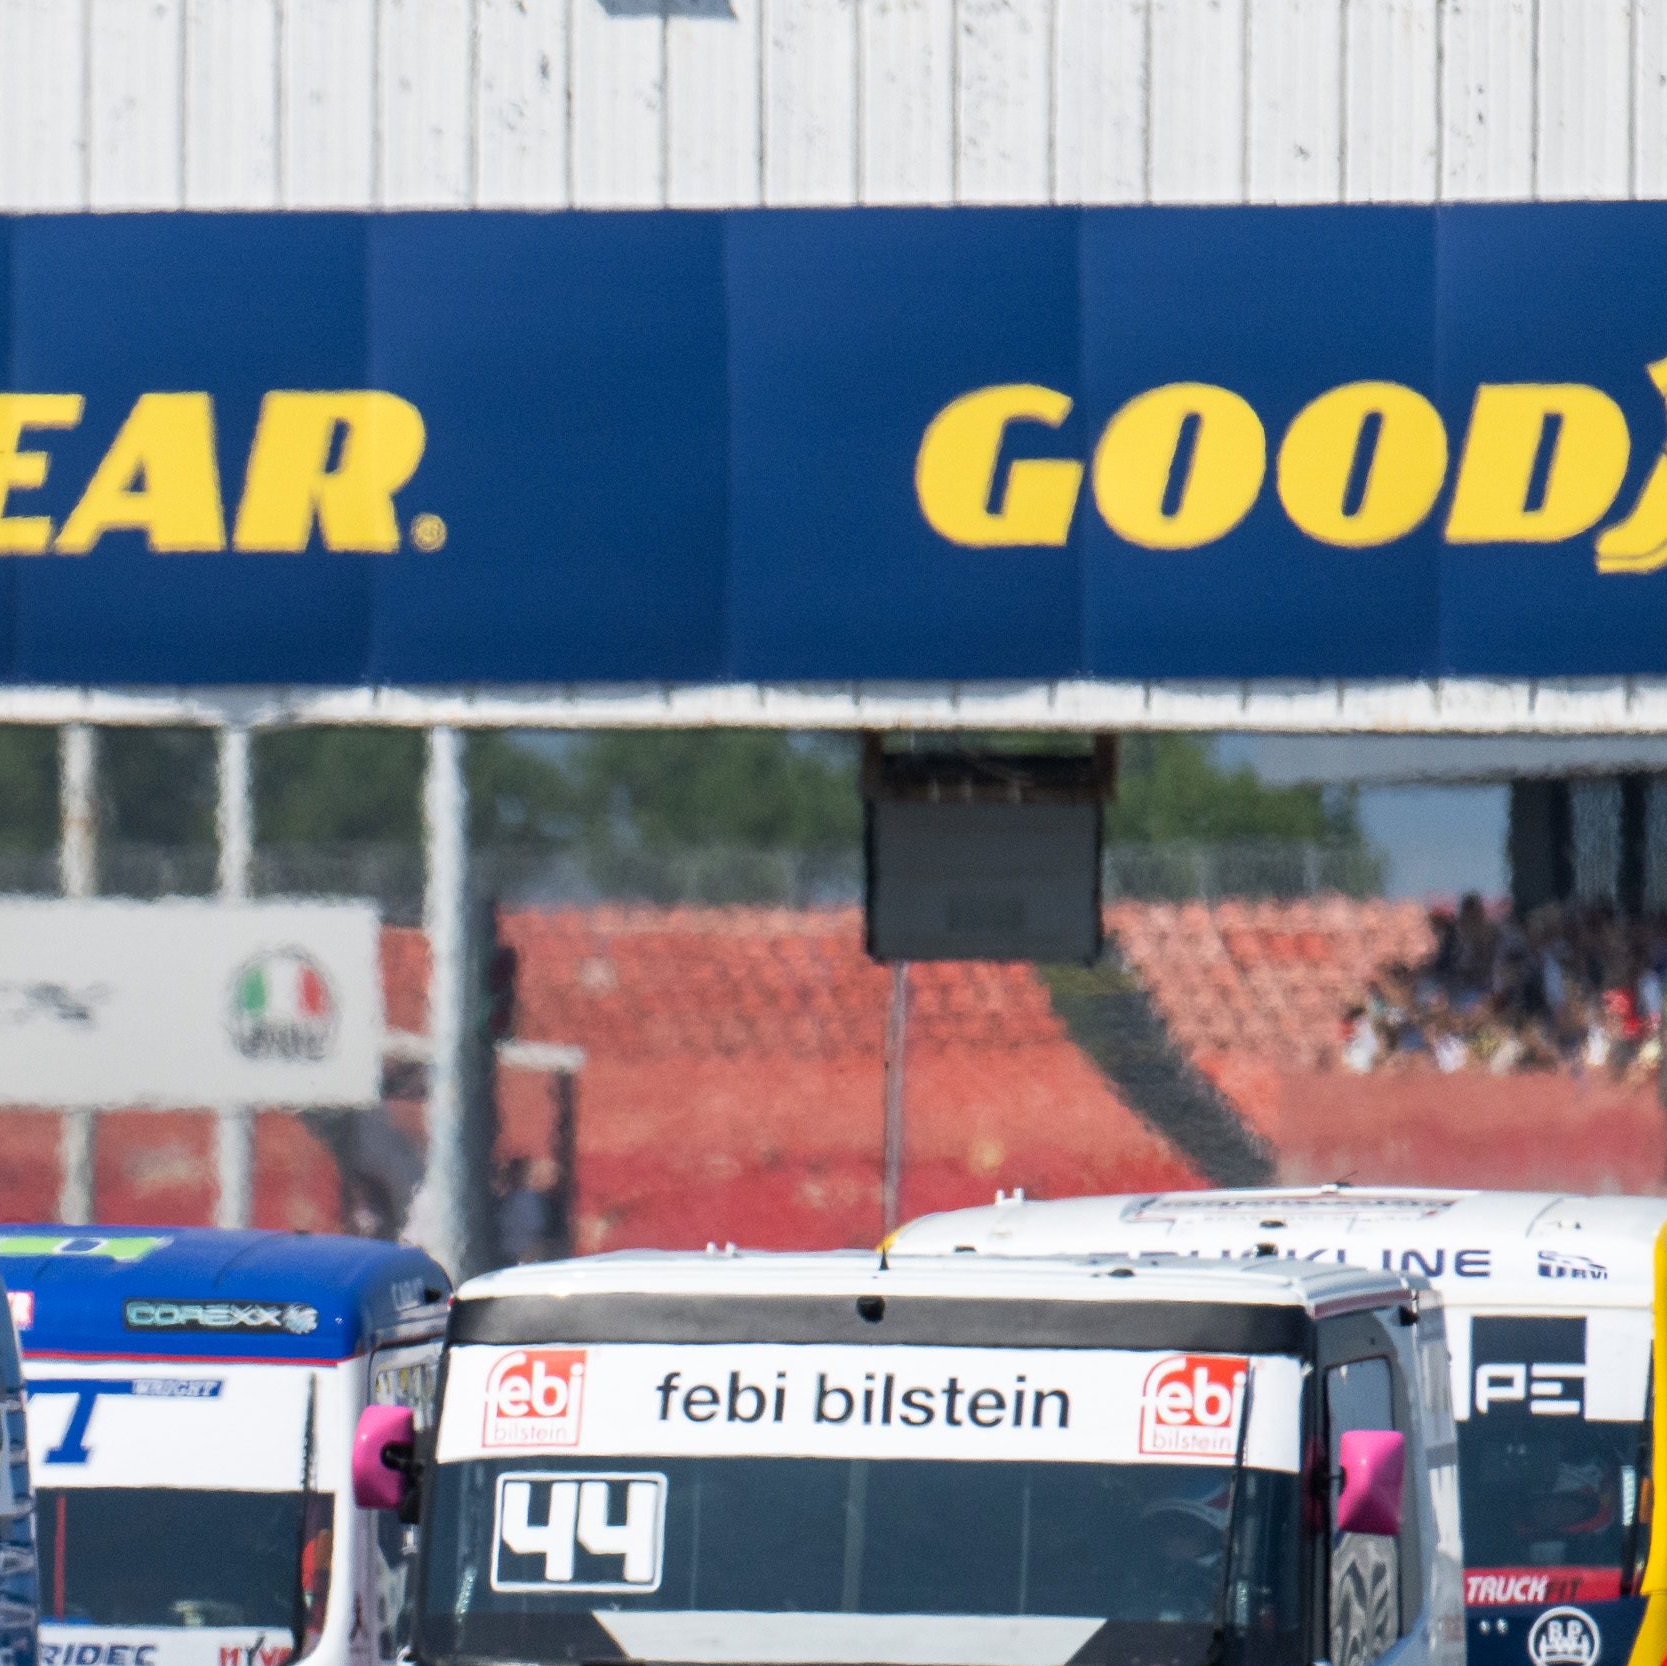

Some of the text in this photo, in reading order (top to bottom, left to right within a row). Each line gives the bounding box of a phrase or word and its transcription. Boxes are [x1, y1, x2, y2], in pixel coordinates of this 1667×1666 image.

[655, 1369, 1071, 1431] febi bilstein
[494, 1422, 568, 1441] bilstein
[1152, 1429, 1232, 1450] bilstein
[501, 1481, 657, 1582] 44
